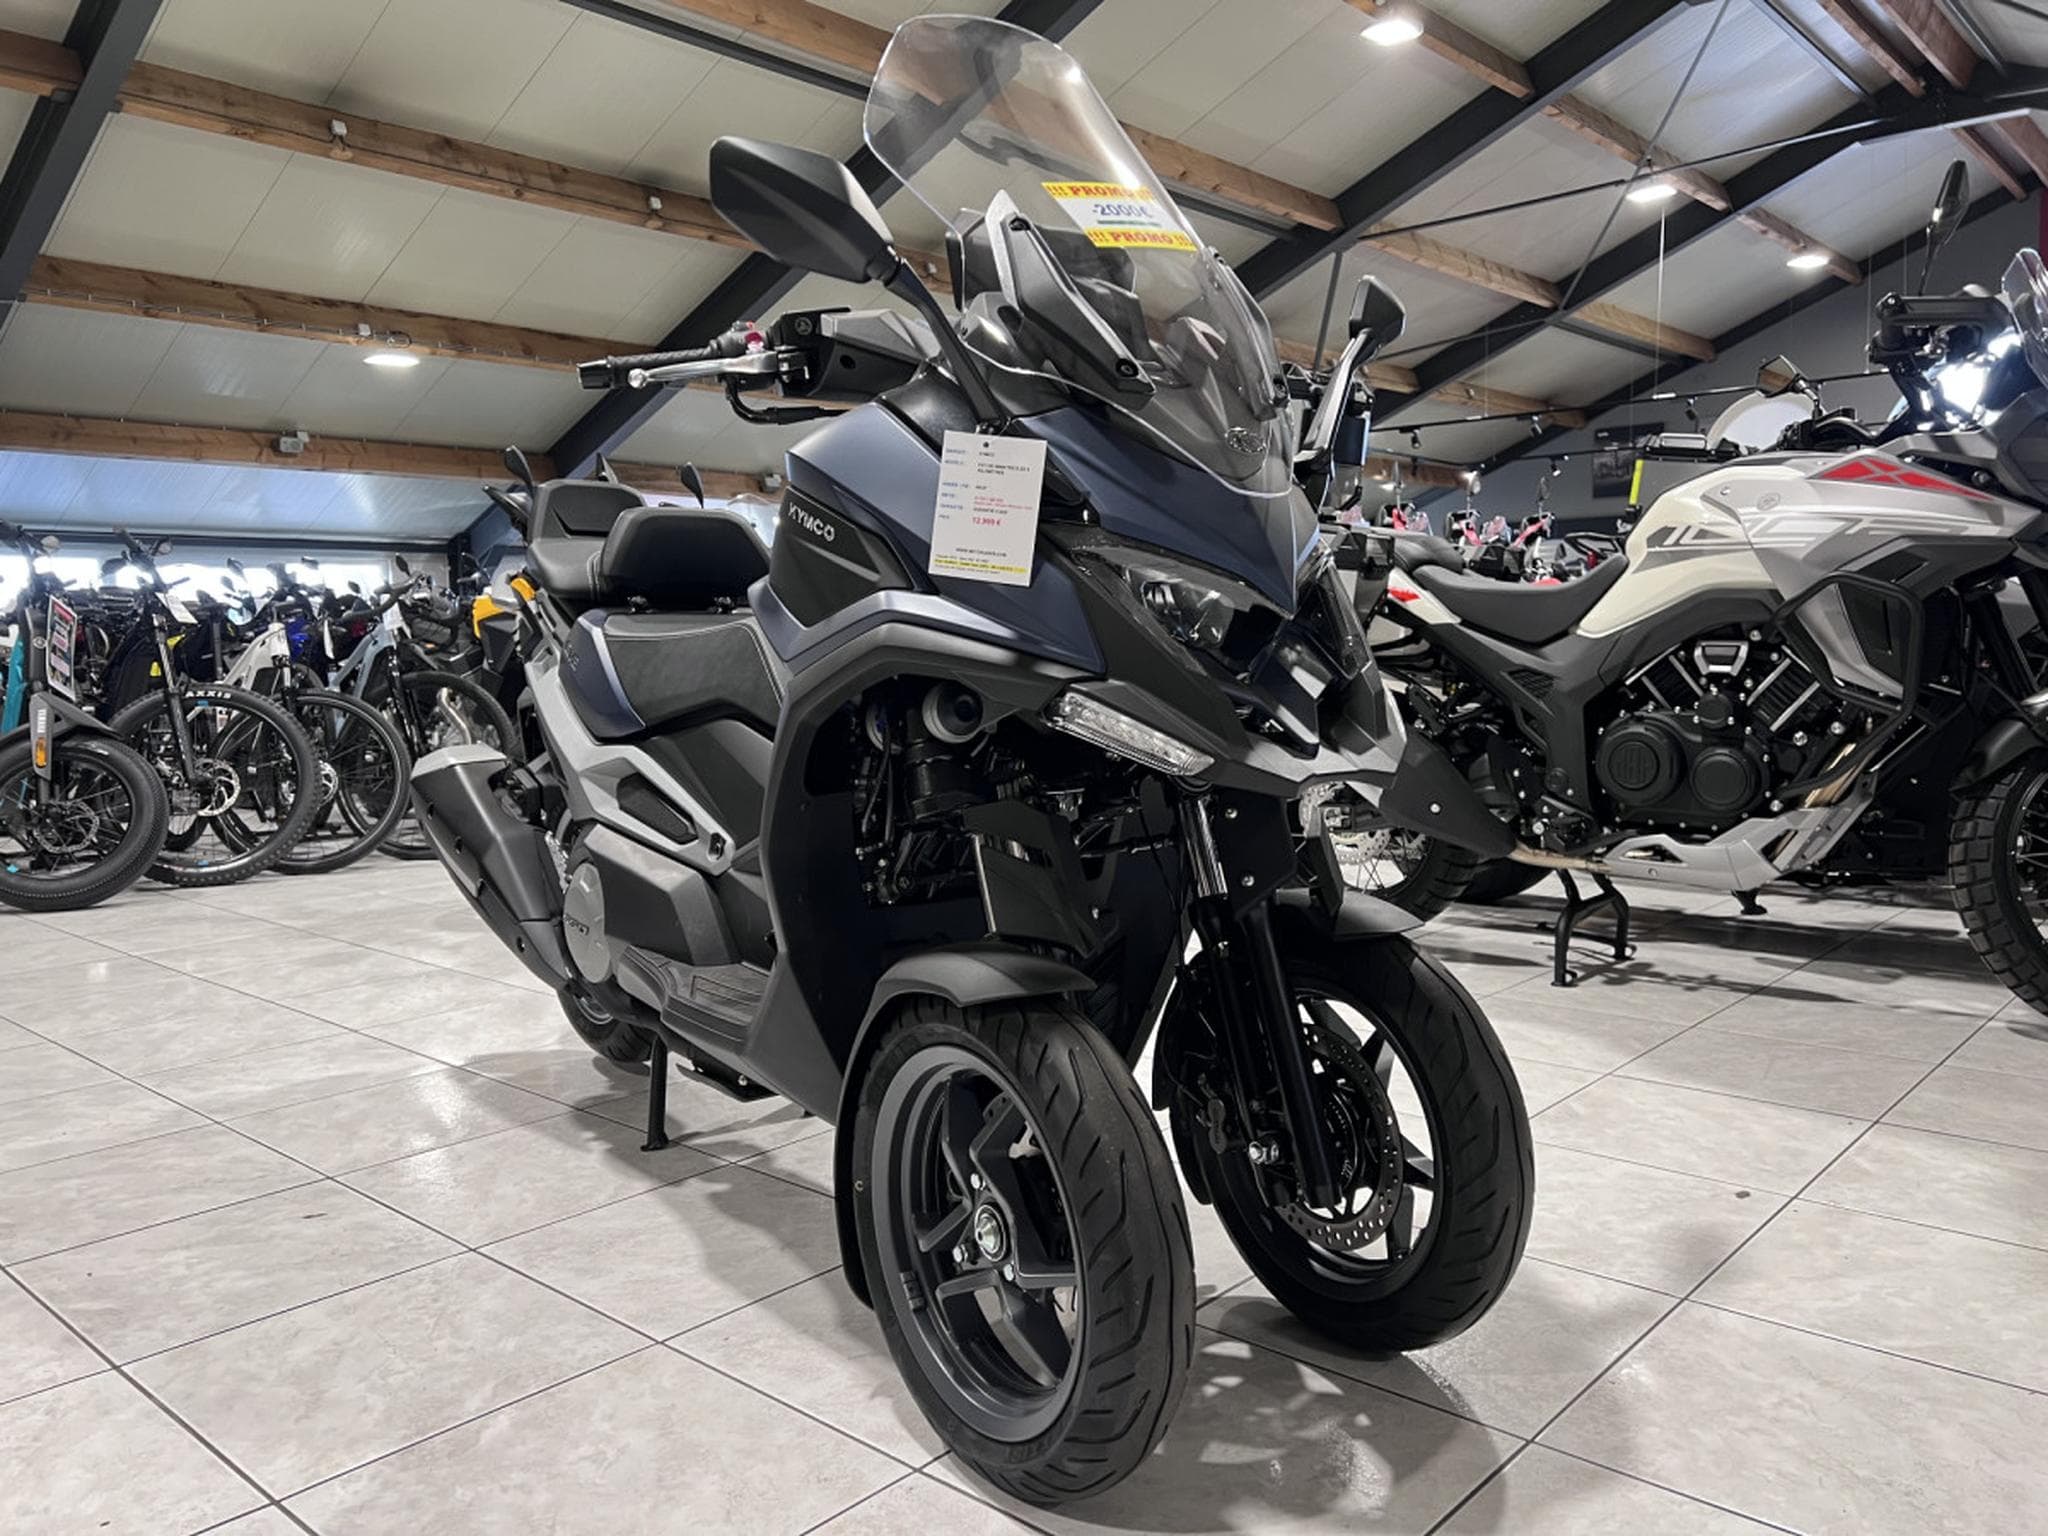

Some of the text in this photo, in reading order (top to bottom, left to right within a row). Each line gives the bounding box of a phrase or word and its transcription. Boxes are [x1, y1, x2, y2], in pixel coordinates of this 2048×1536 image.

[1068, 185, 1135, 198] PROMO
[1110, 232, 1174, 245] PROMO
[788, 501, 836, 542] KYMCO
[185, 690, 232, 699] AXXIS
